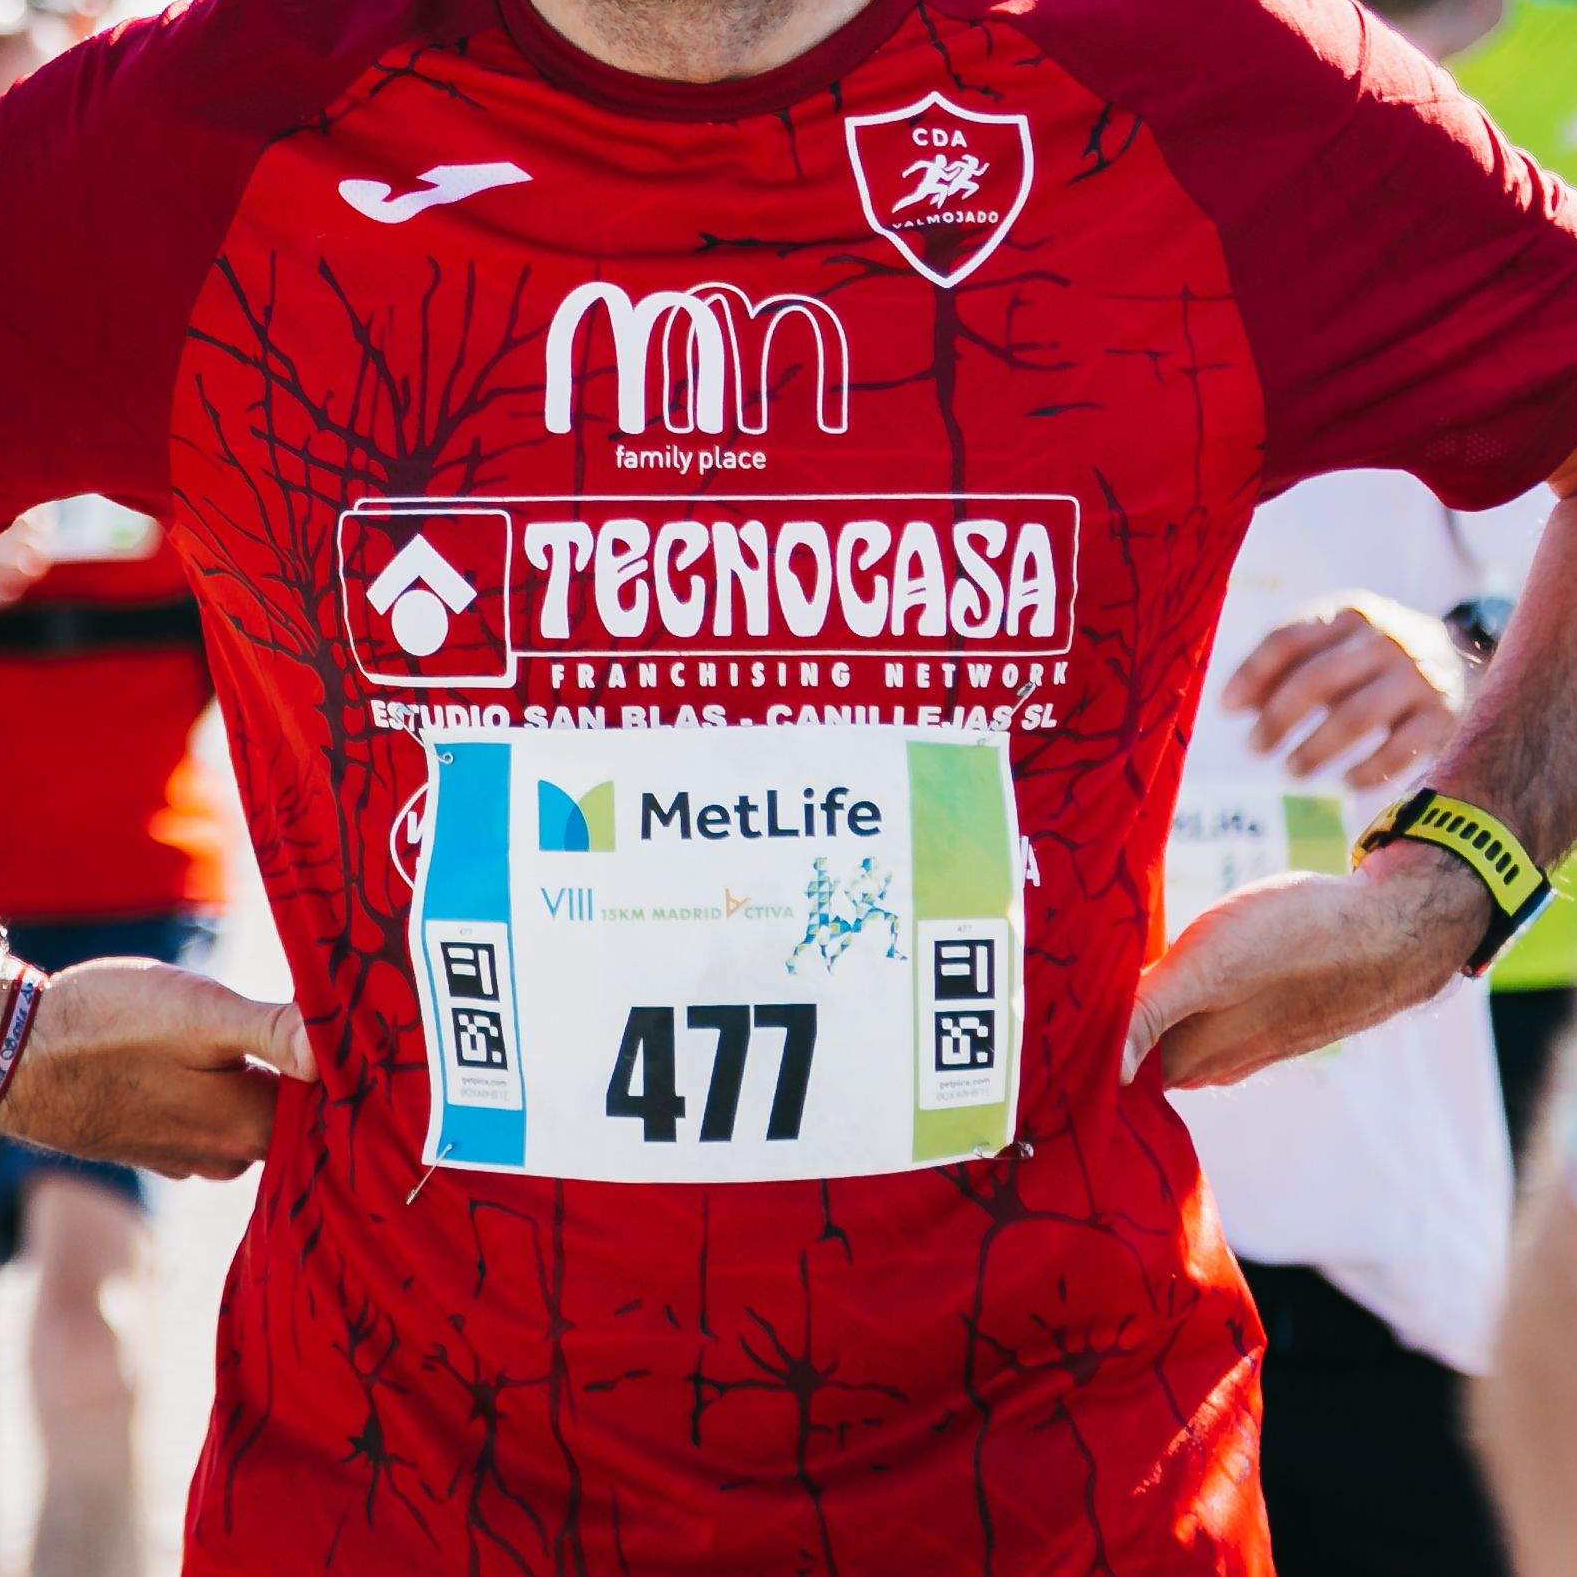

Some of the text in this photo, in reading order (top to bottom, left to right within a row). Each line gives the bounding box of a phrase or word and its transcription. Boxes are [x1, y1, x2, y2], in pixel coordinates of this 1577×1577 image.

[912, 127, 968, 148] CDA
[615, 444, 767, 475] family place
[524, 519, 1056, 640] TECNOCASA
[551, 660, 1069, 690] FRANCHISING NETWORK
[370, 699, 512, 731] ESTUDIO
[523, 704, 605, 730] SAN
[621, 703, 727, 730] BLAS
[1021, 702, 1058, 731] SL
[641, 786, 882, 840] MetLife
[540, 887, 594, 921] VIII
[600, 908, 646, 922] 15KM
[651, 907, 722, 922] MADRID
[606, 1003, 817, 1143] 477
